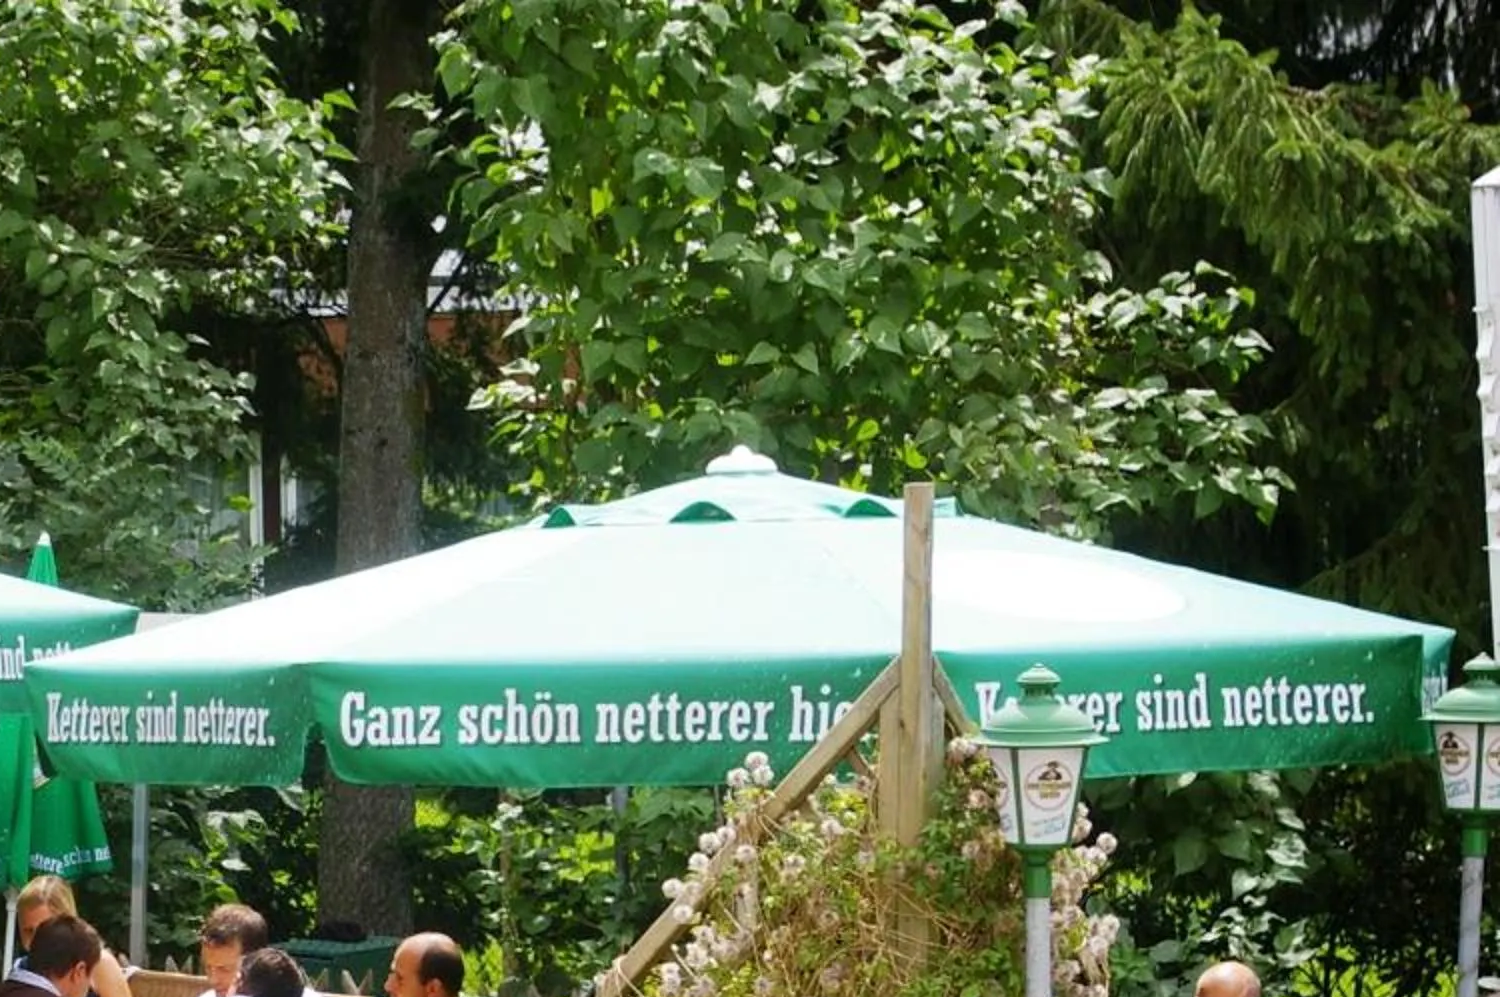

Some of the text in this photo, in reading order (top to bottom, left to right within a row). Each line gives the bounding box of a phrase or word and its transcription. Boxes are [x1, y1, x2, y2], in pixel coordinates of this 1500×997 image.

[46, 690, 276, 747] Ketterer sind netterer.
[339, 690, 442, 747] Ganz
[457, 687, 582, 746] schön
[594, 691, 775, 744] netterer
[1135, 671, 1212, 732] sind
[1221, 676, 1375, 728] netterer.
